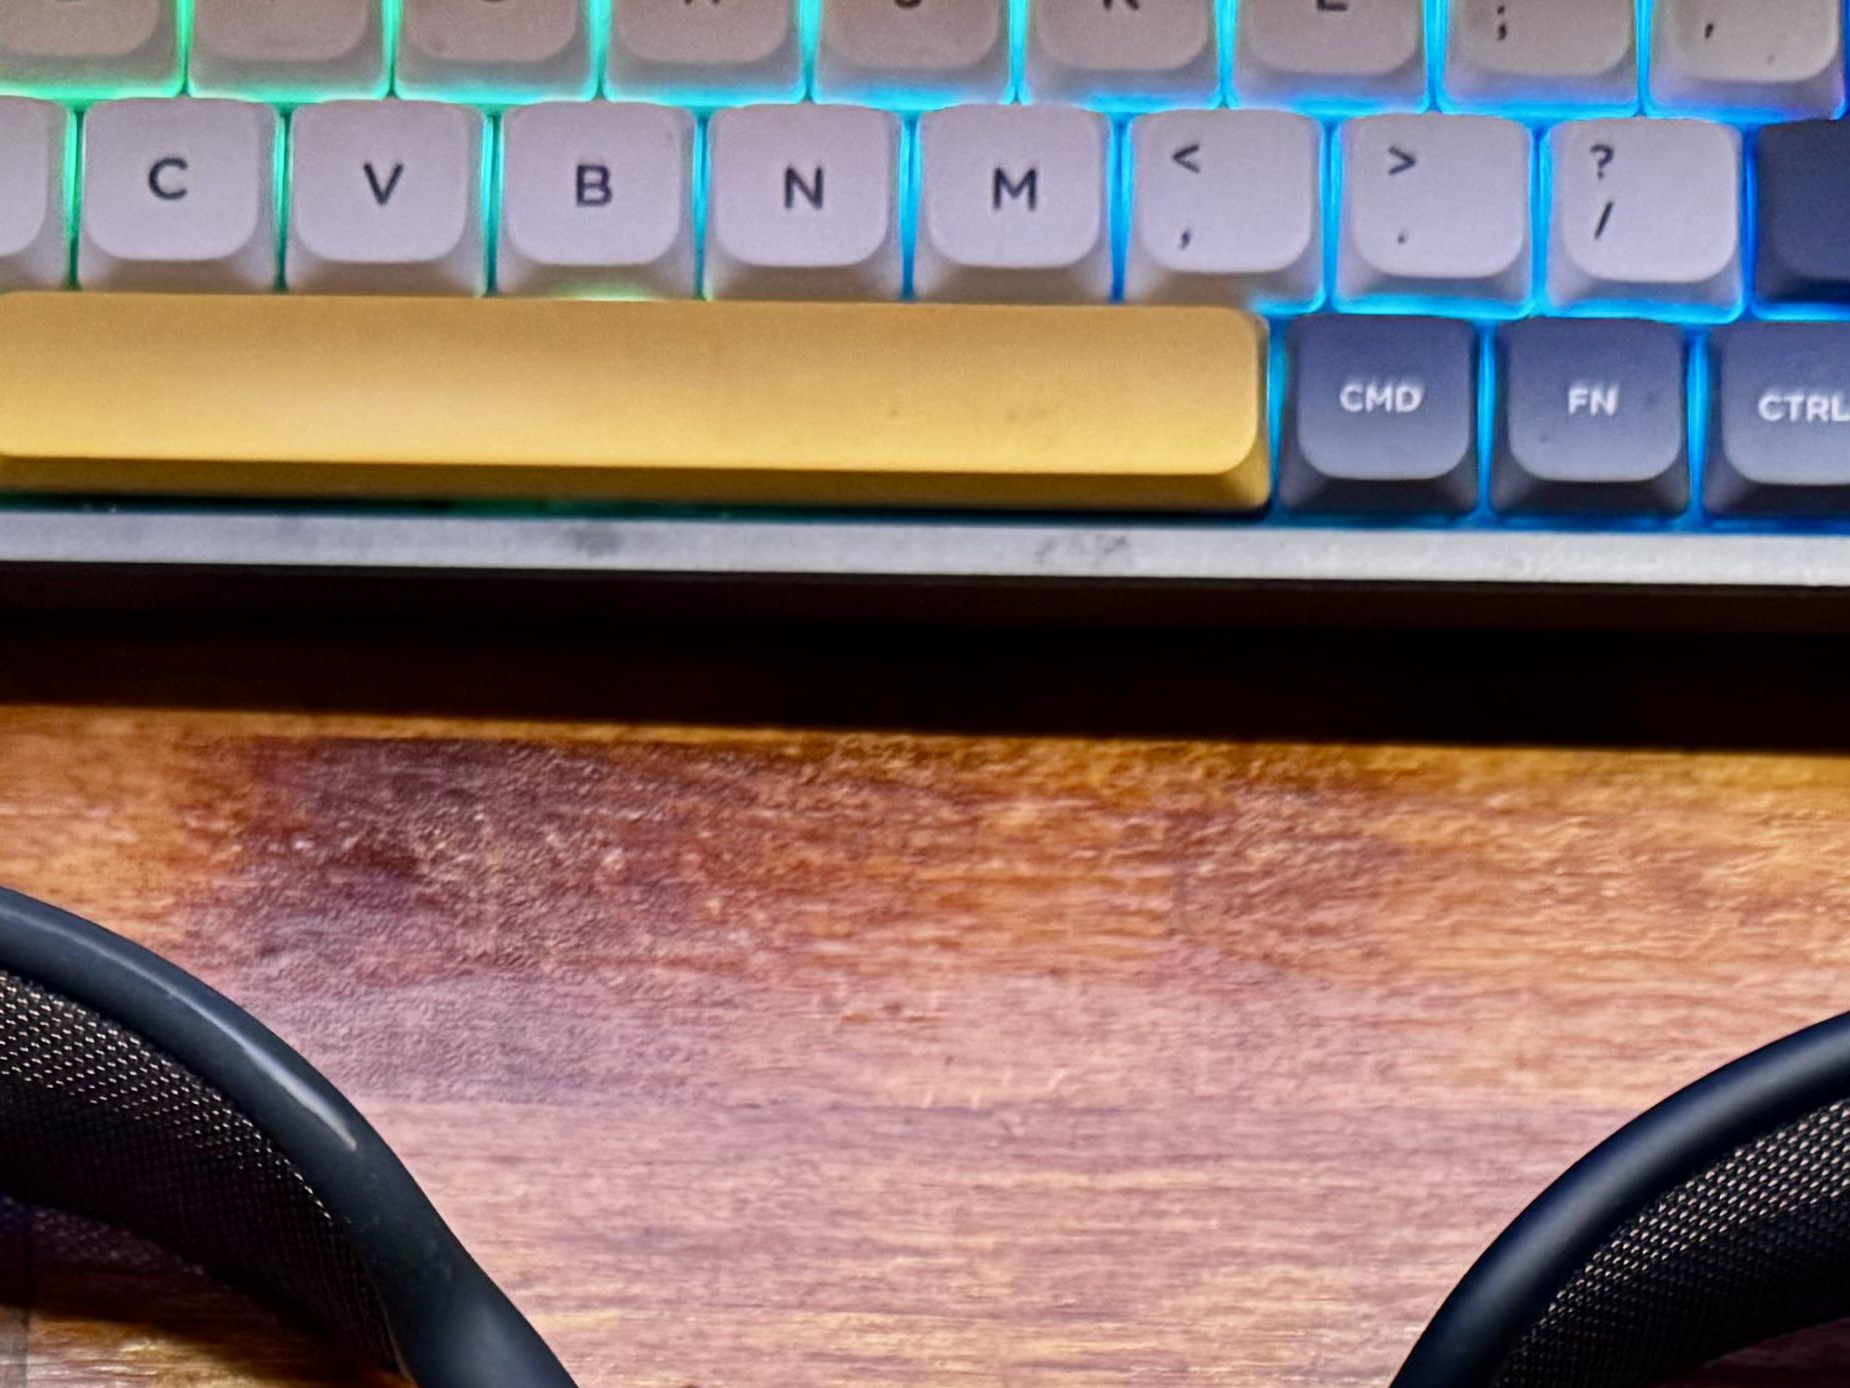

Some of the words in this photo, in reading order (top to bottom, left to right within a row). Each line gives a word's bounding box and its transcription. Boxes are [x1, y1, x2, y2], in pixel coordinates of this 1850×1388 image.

[1172, 143, 1200, 173] <
[1388, 146, 1416, 175] >
[1590, 143, 1615, 179] ?
[148, 157, 188, 200] C
[363, 162, 404, 206] V
[575, 163, 613, 206] B
[784, 166, 824, 209] N
[993, 167, 1038, 210] M
[1594, 201, 1614, 239] /
[1340, 384, 1422, 413] CMD
[1568, 386, 1618, 415] FN
